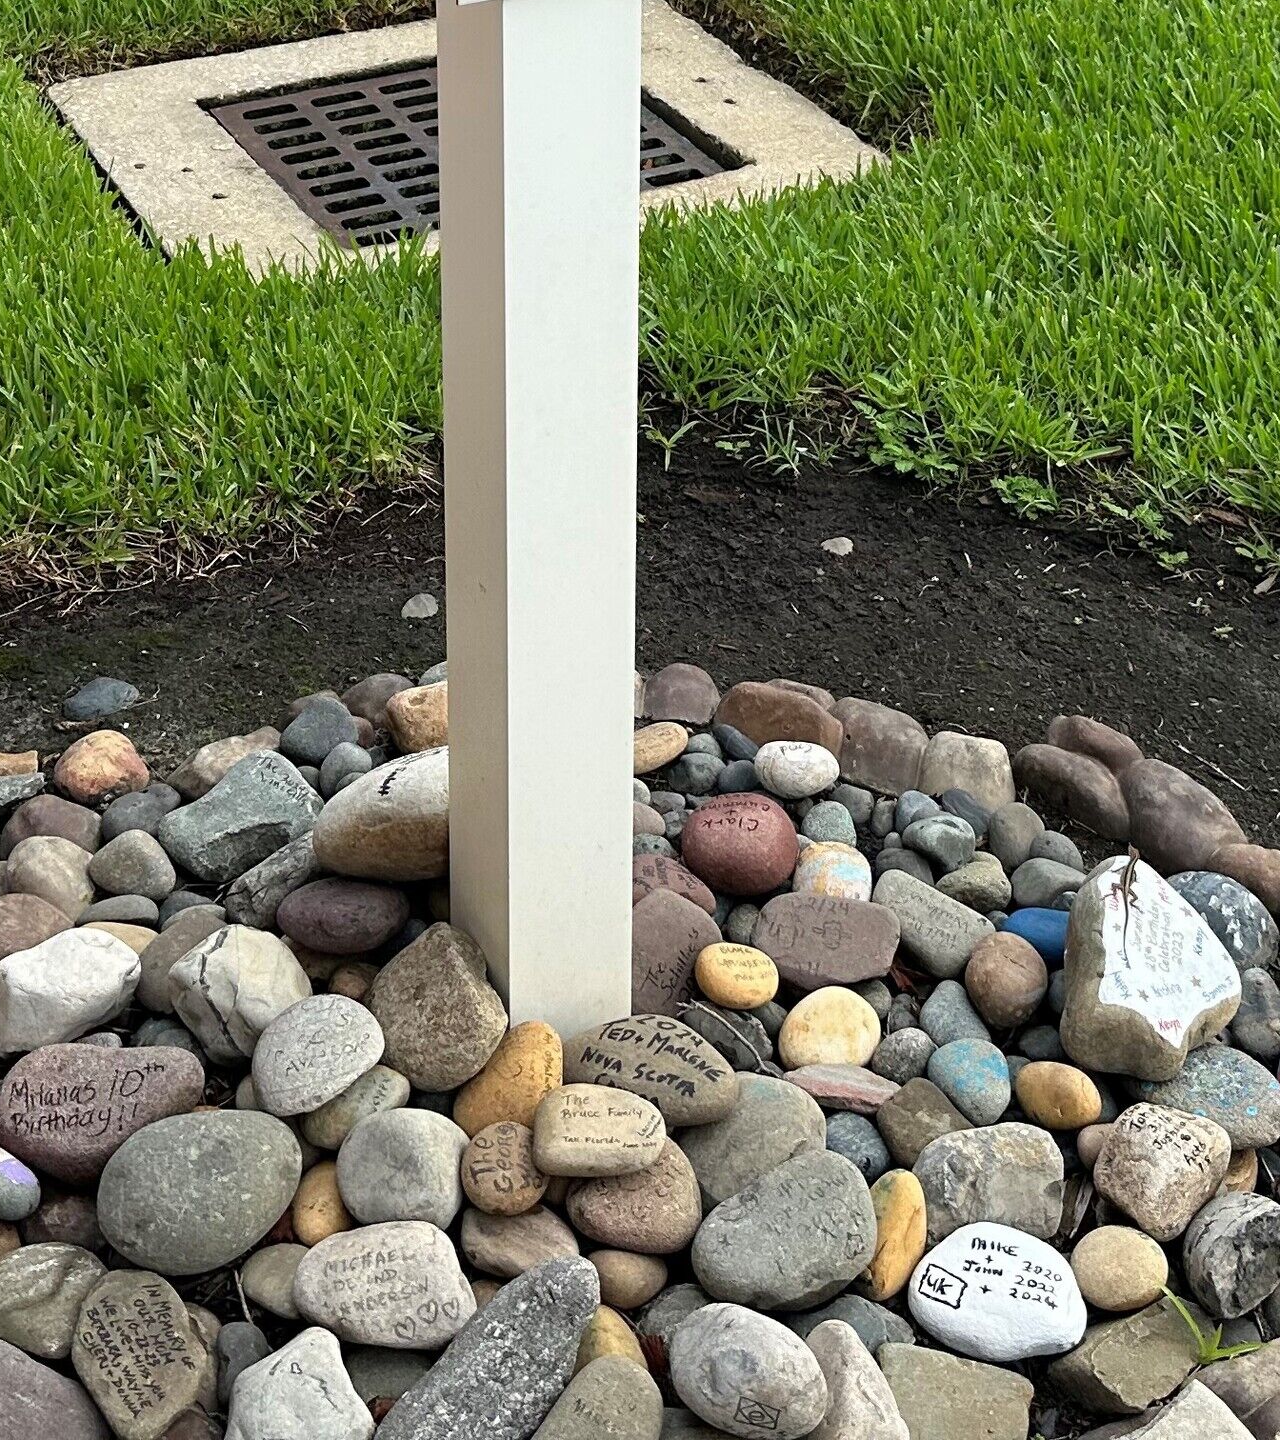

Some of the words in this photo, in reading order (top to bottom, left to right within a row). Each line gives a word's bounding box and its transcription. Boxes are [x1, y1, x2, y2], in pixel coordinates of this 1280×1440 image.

[580, 1046, 623, 1074] NOVA
[561, 1094, 590, 1106] The
[608, 1106, 643, 1119] Family
[972, 1237, 1019, 1257] MIKE
[99, 1296, 117, 1318] WE
[133, 1298, 156, 1330] OUR
[149, 1334, 176, 1366] MOM
[151, 1300, 187, 1352] MEMORY
[121, 1365, 154, 1409] WAYNE
